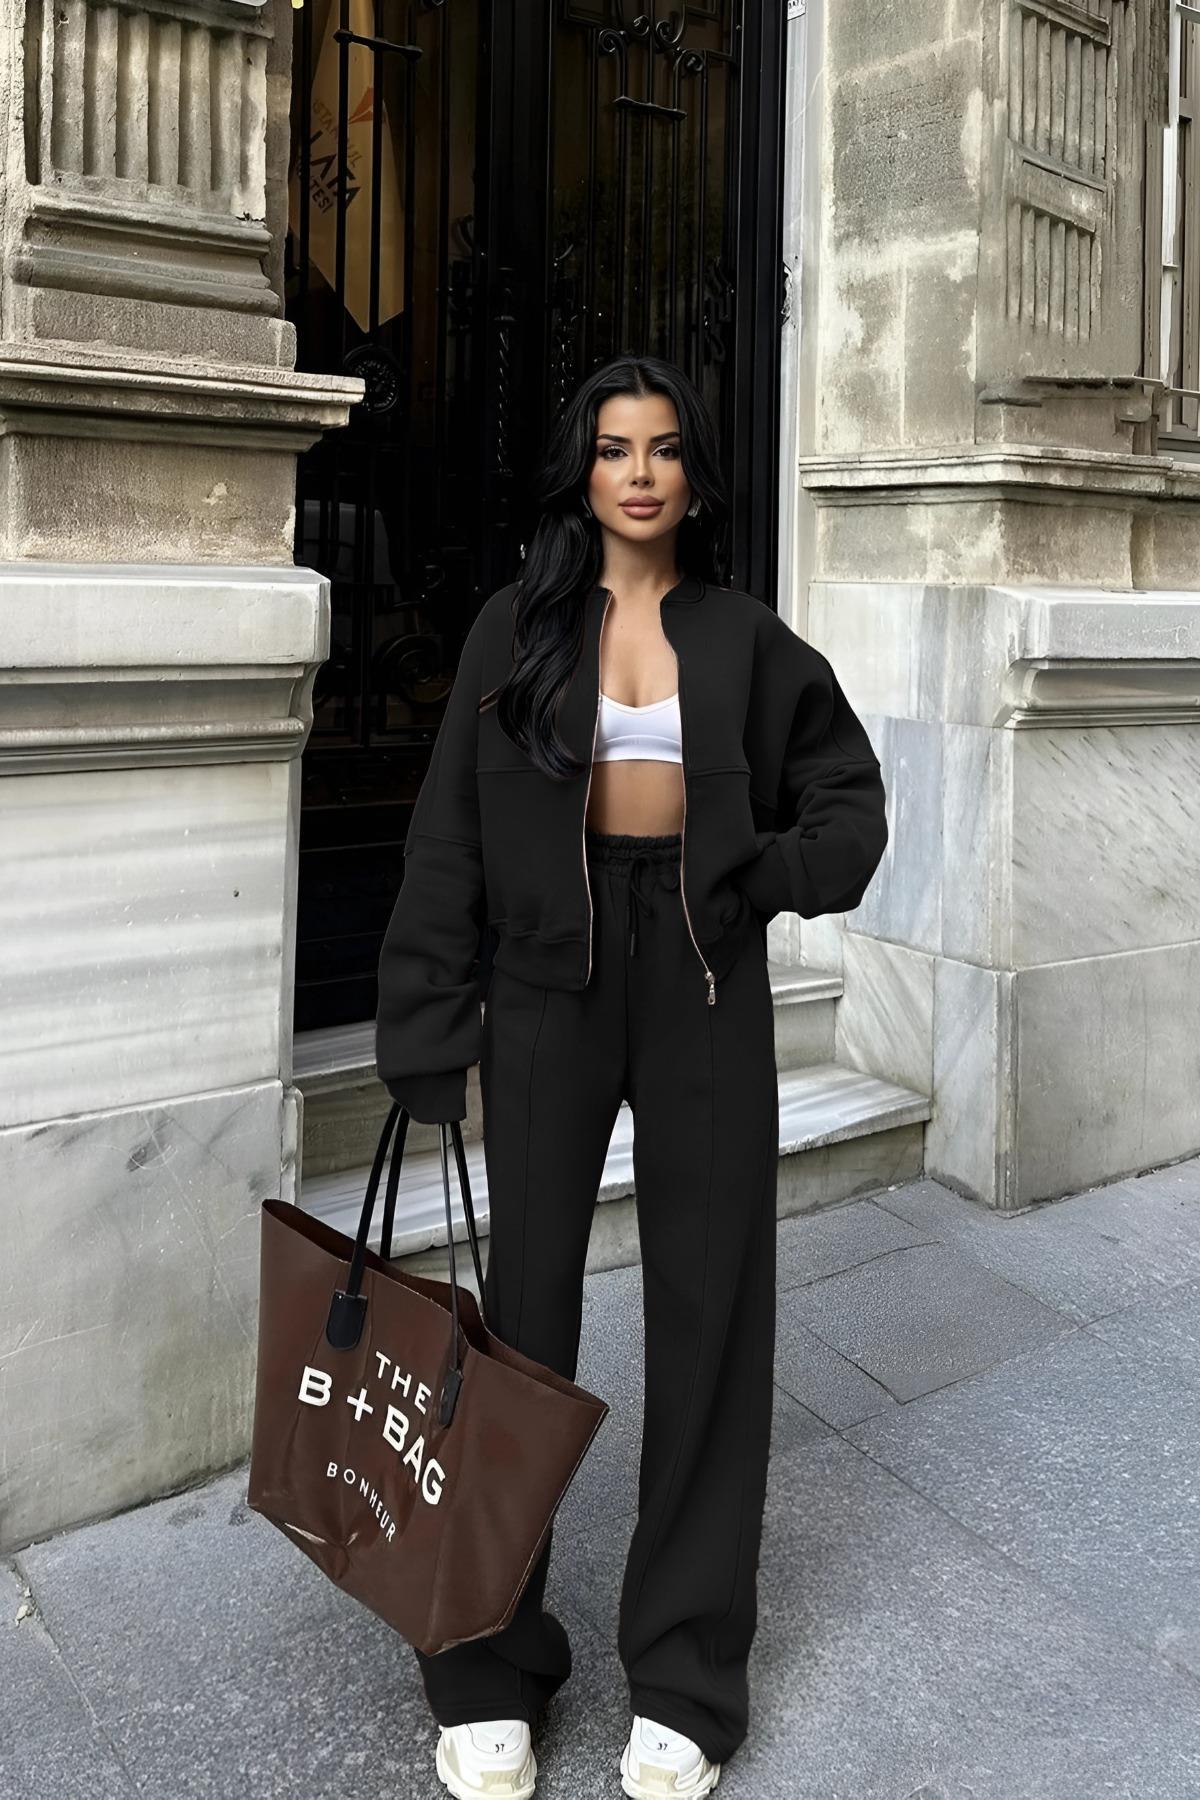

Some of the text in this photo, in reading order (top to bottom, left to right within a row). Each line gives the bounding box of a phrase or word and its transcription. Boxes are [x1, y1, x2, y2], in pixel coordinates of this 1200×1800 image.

[375, 1350, 432, 1415] THE
[298, 1365, 333, 1407] B
[382, 1403, 446, 1505] BAG
[326, 1461, 396, 1543] BONHEUR
